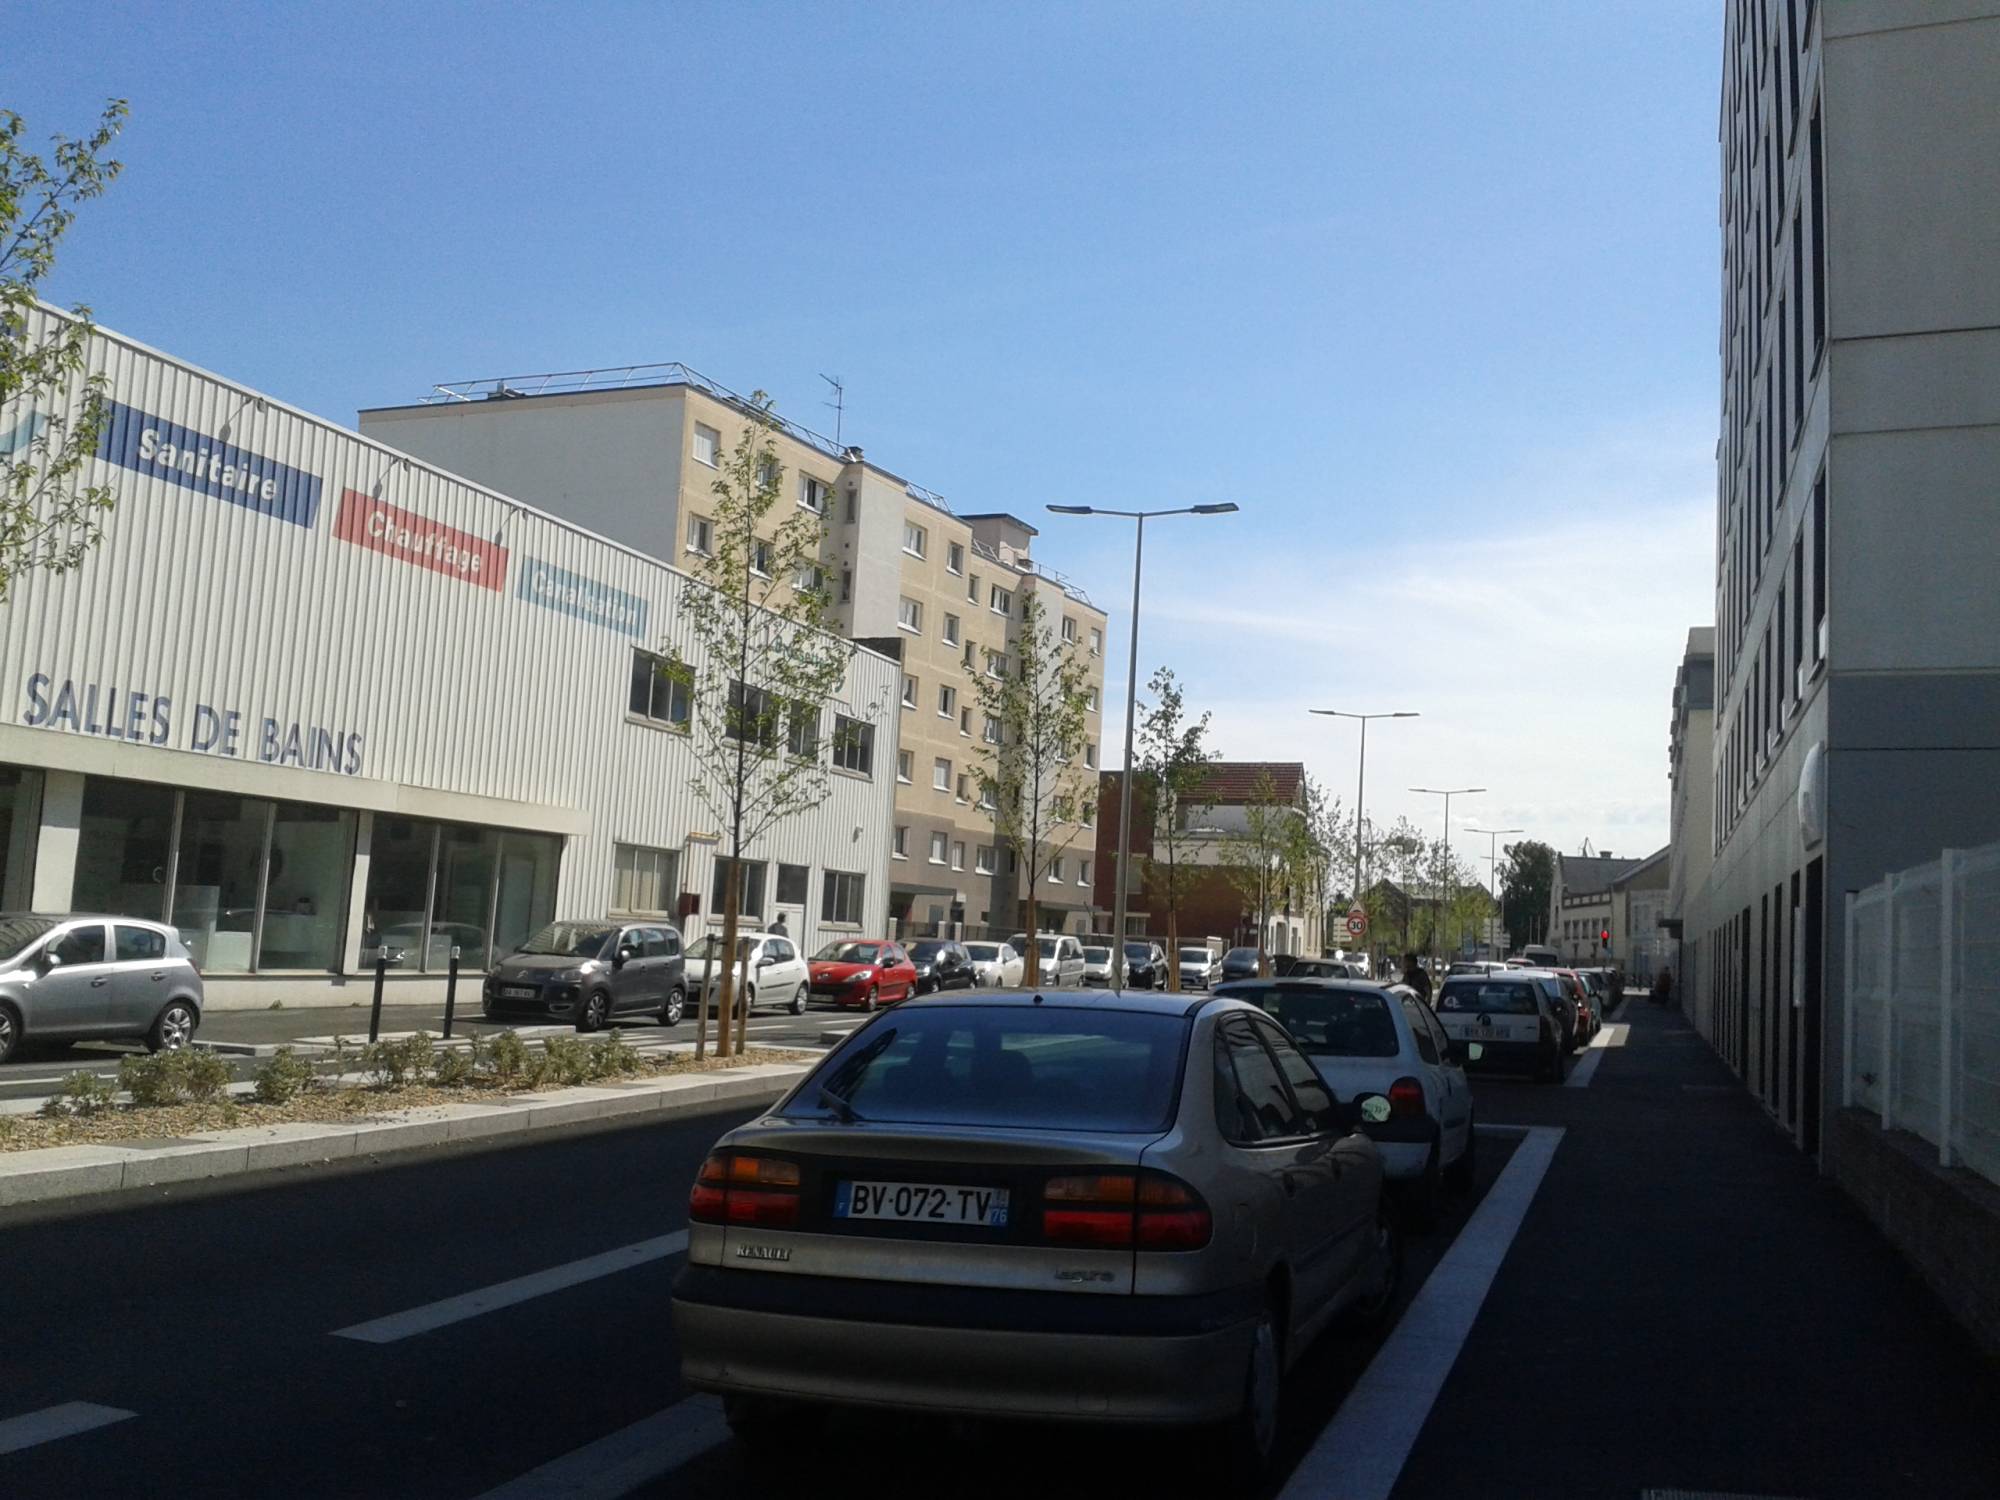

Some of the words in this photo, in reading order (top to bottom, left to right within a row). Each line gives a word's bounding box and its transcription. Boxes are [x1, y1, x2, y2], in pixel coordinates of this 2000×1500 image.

[140, 428, 276, 500] Sanitaire
[367, 511, 481, 573] Chauffage
[532, 570, 637, 625] Canalisation
[23, 672, 172, 747] SALLES
[191, 703, 241, 756] DE
[259, 717, 362, 775] BAINS
[1351, 920, 1363, 930] 30
[991, 1209, 1008, 1224] 76
[736, 1245, 792, 1261] RENAULT
